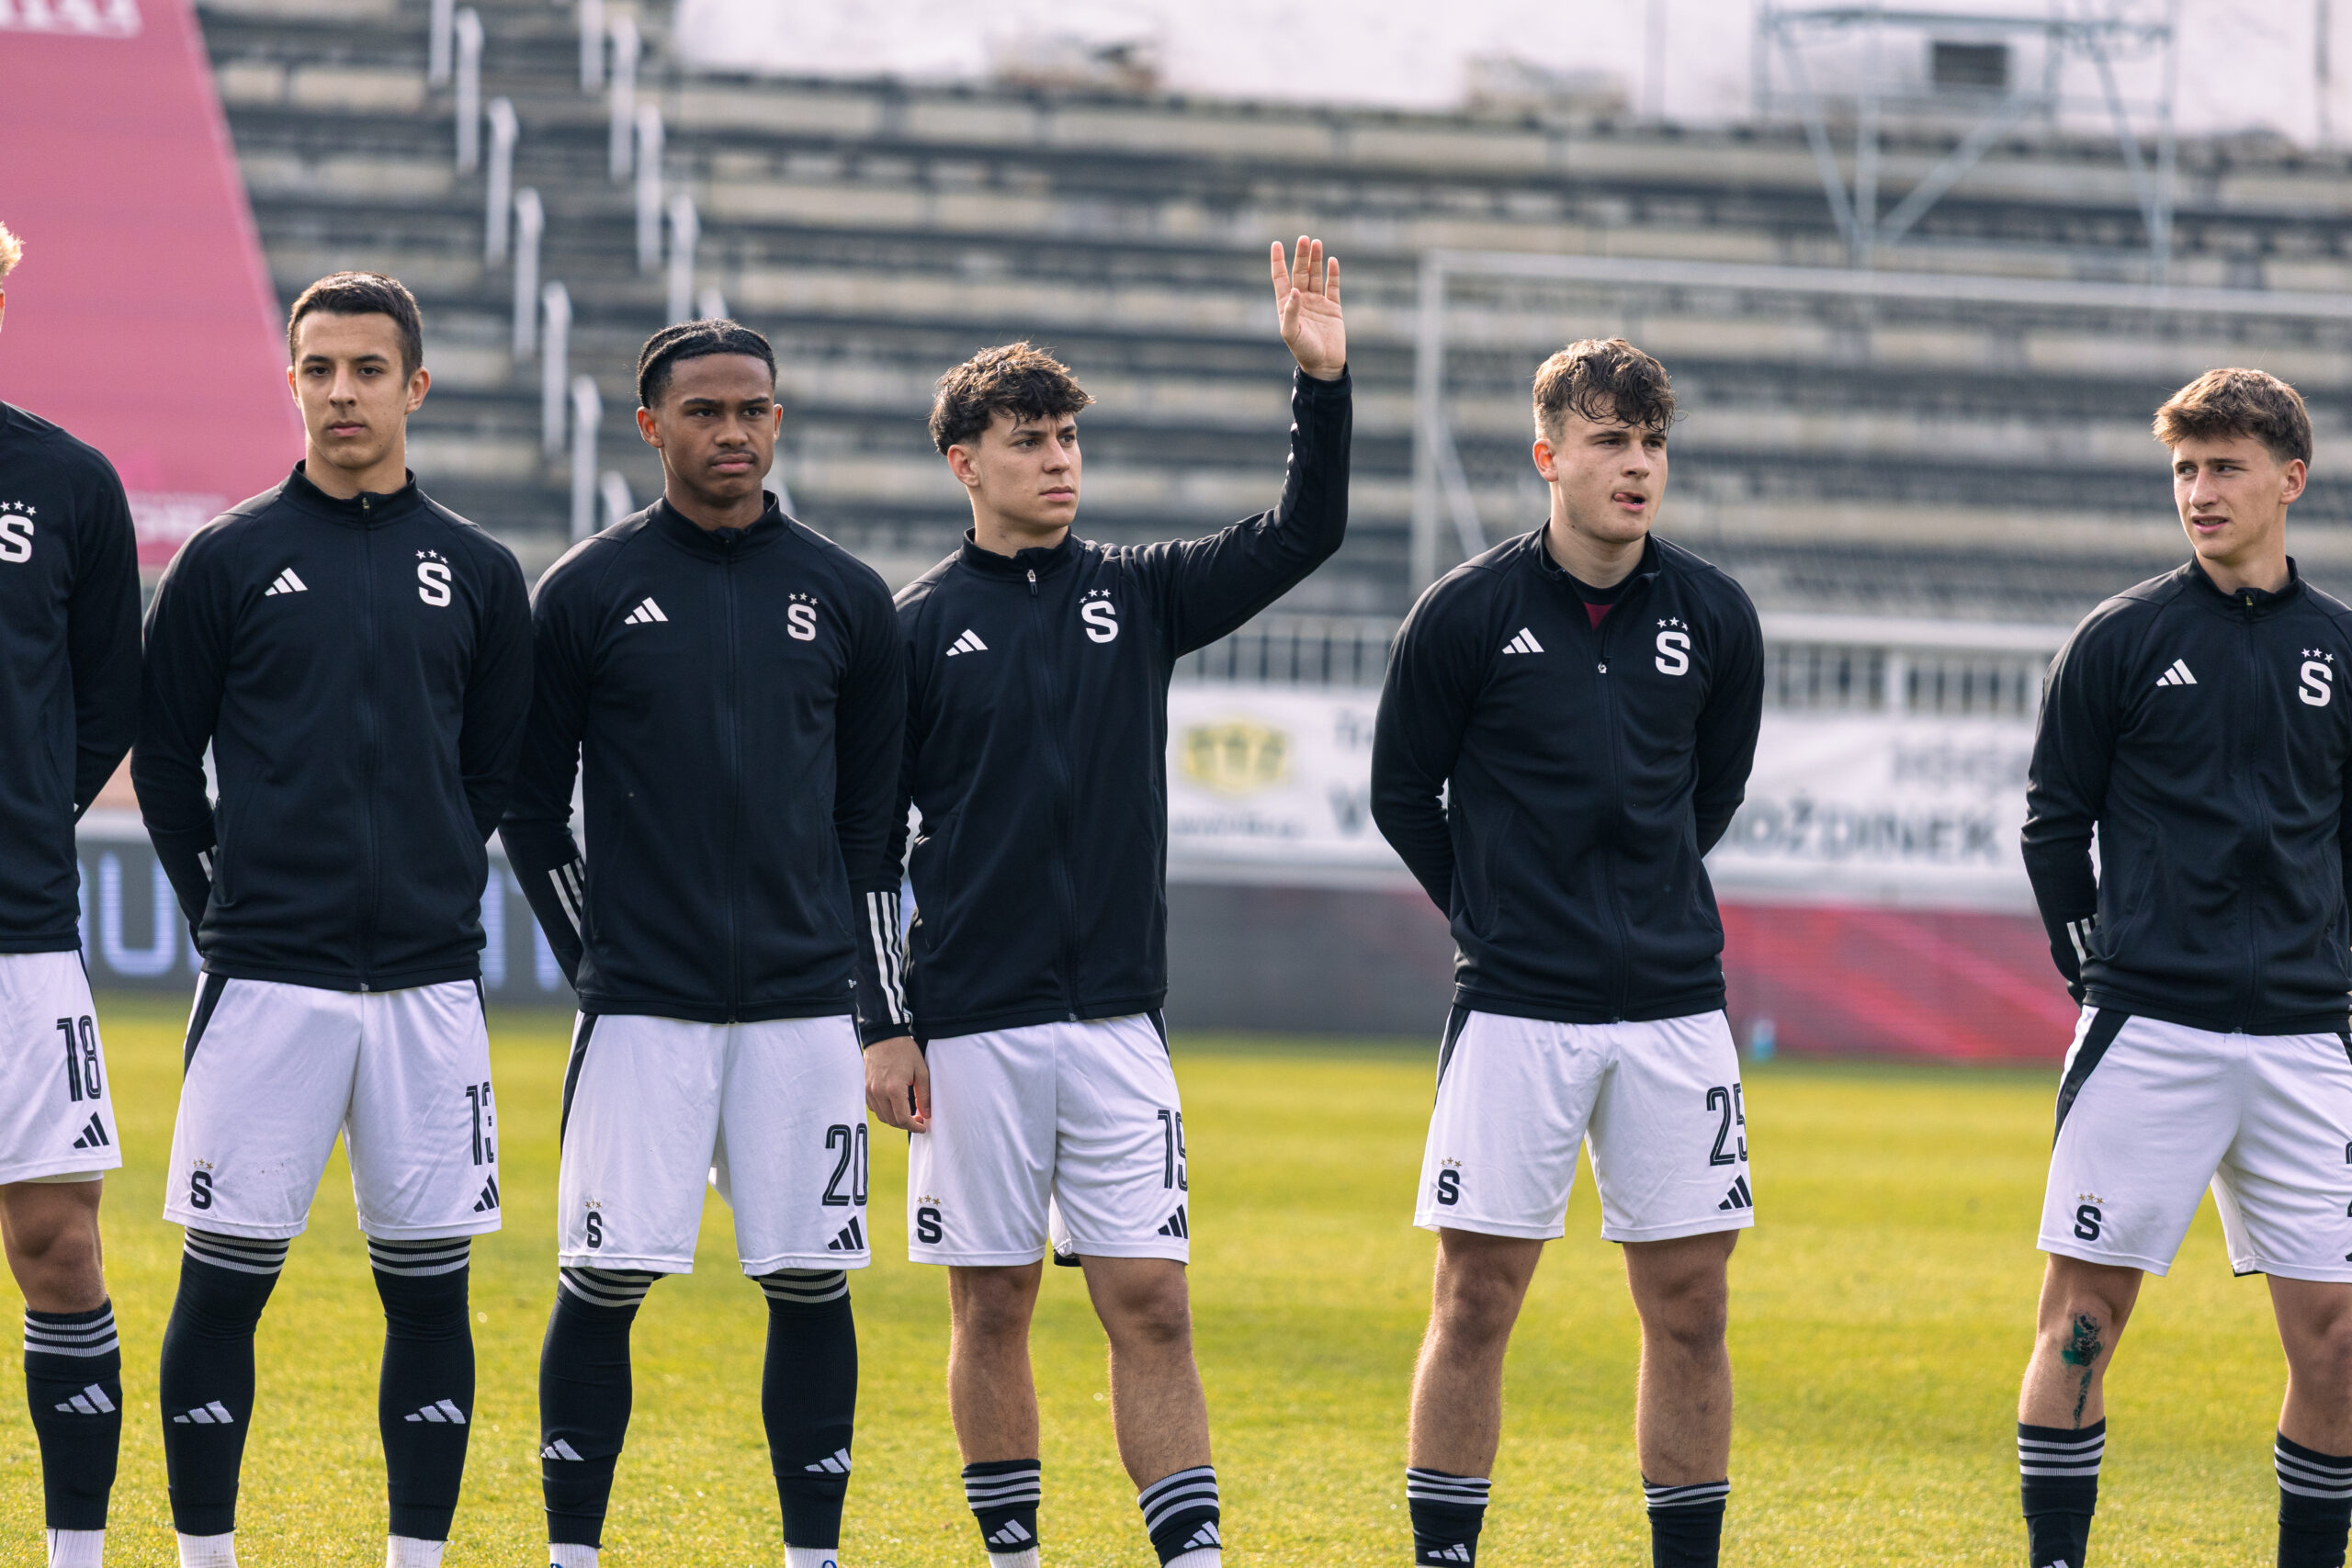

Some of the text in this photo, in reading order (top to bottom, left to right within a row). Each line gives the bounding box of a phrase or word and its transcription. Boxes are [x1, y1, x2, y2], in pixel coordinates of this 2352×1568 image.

[0, 514, 34, 563] S
[417, 561, 452, 607] S
[786, 603, 818, 641] S
[1080, 600, 1120, 644] S
[1655, 630, 1690, 676] S
[2298, 660, 2334, 707] S
[56, 1015, 102, 1102] 18
[1706, 1082, 1748, 1167] 25
[821, 1122, 868, 1207] 20
[1437, 1168, 1461, 1206] S
[190, 1170, 213, 1211] S
[585, 1211, 603, 1249] S
[917, 1206, 943, 1245] S
[2074, 1204, 2102, 1242] S
